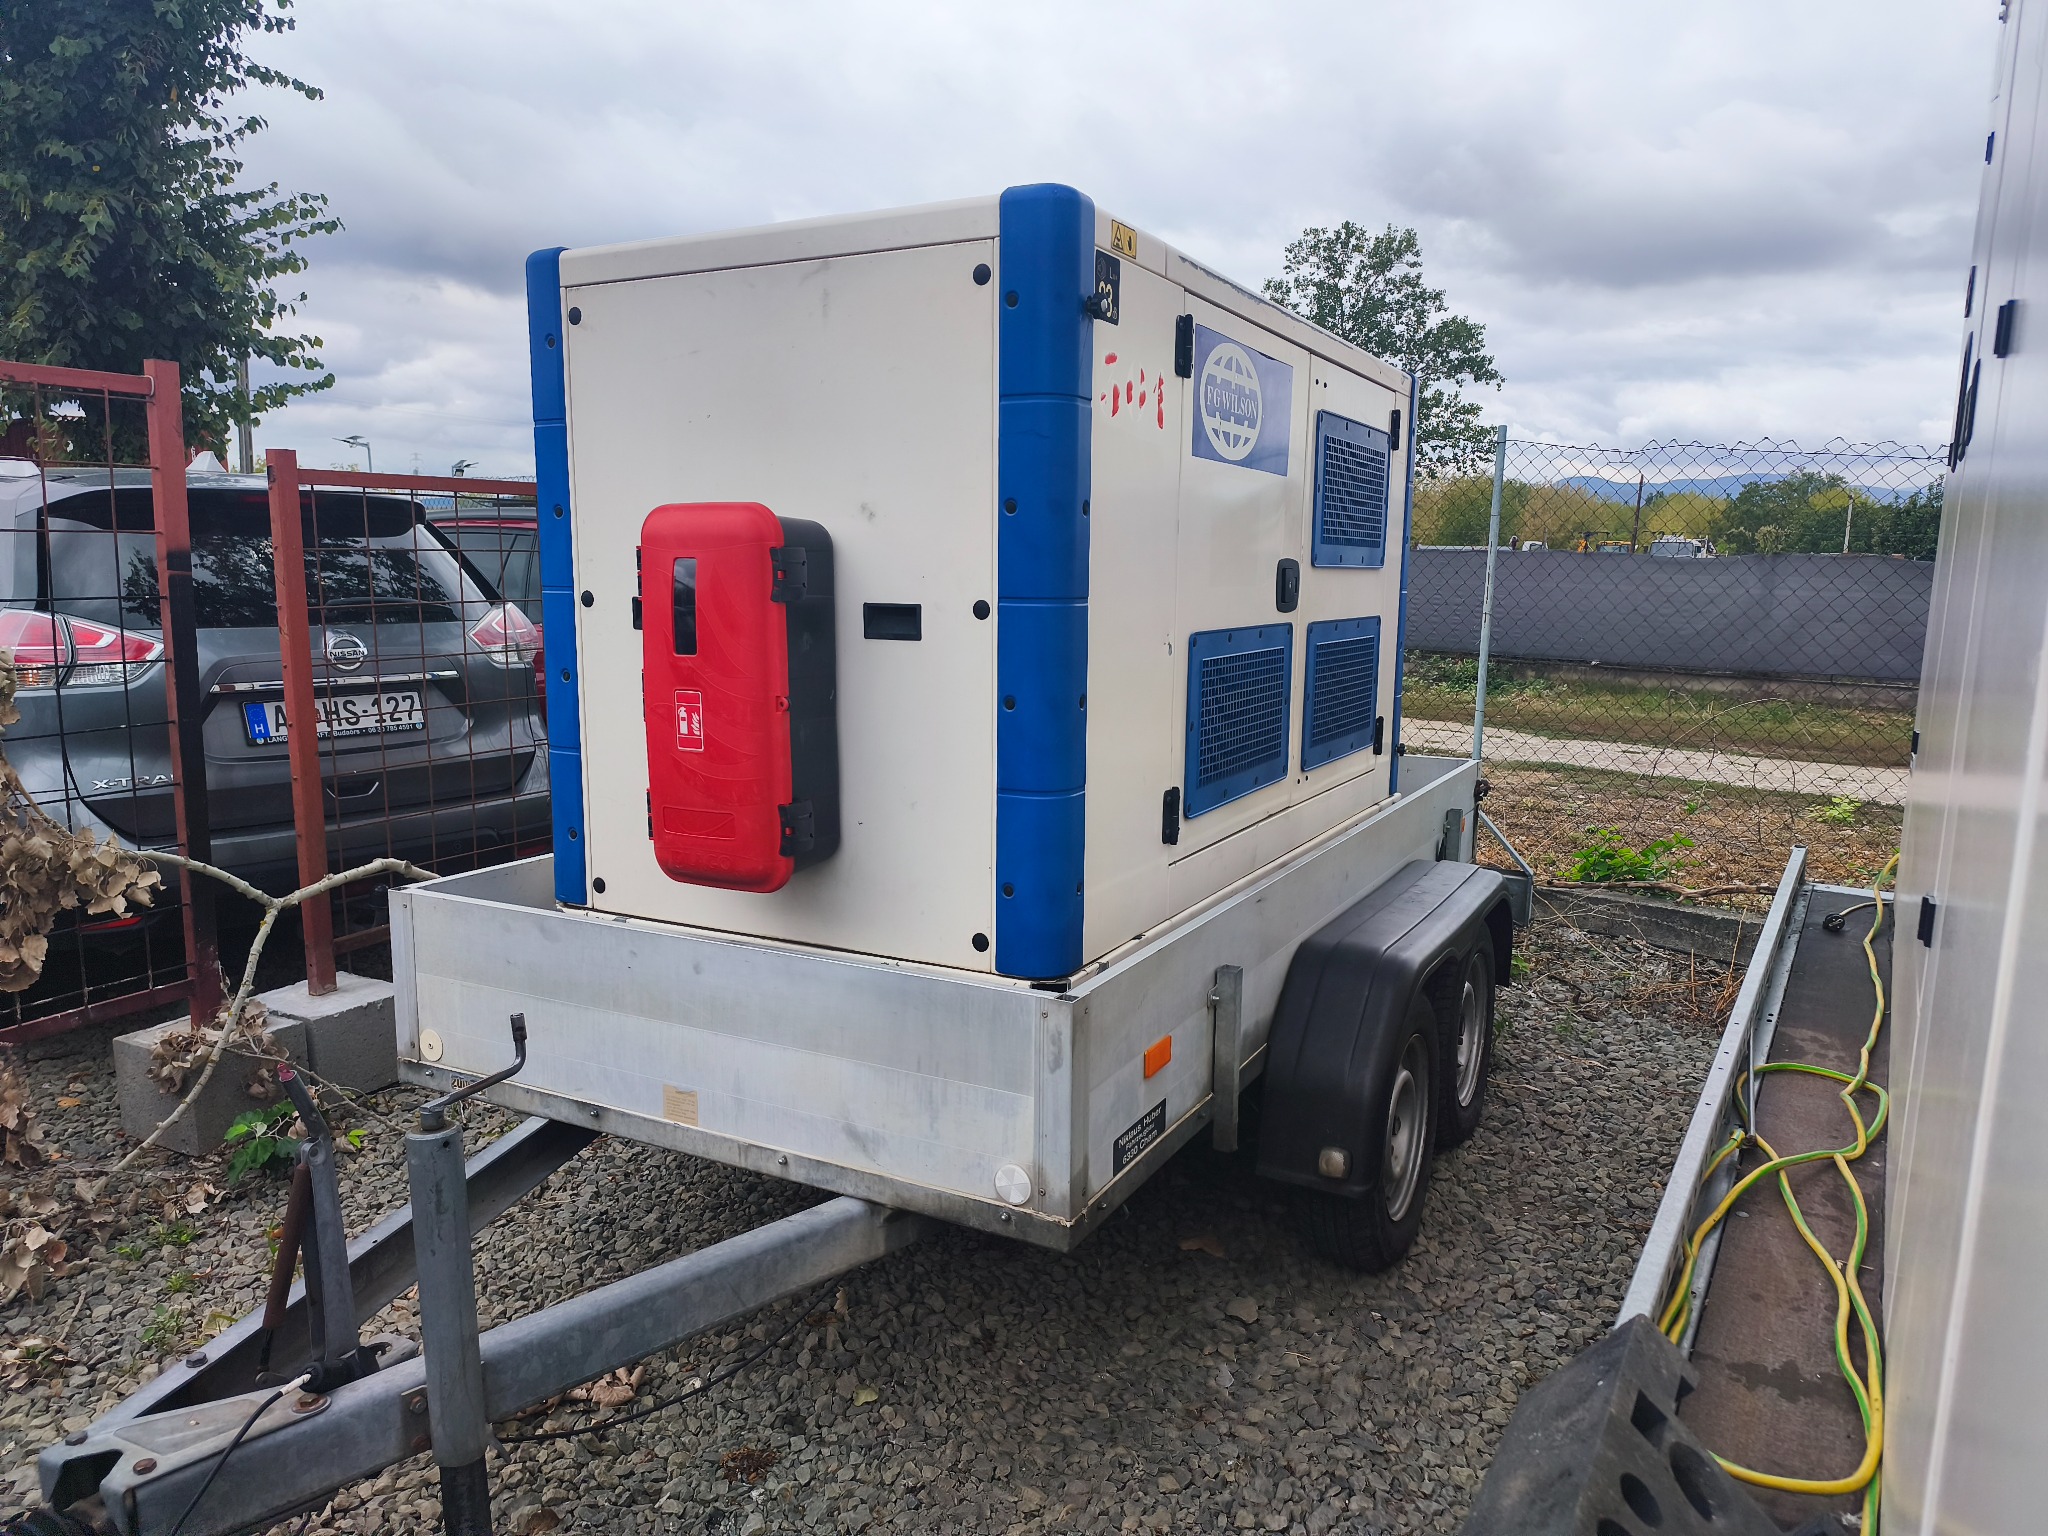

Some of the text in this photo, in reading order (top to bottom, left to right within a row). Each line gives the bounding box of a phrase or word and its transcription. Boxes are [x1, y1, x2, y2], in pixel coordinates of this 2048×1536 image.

[1207, 385, 1258, 420] FG WILSON
[254, 723, 265, 734] H
[92, 773, 174, 791] X-TRA
[1118, 1106, 1162, 1149] Niklaus Huber
[1139, 1129, 1158, 1149] Cham
